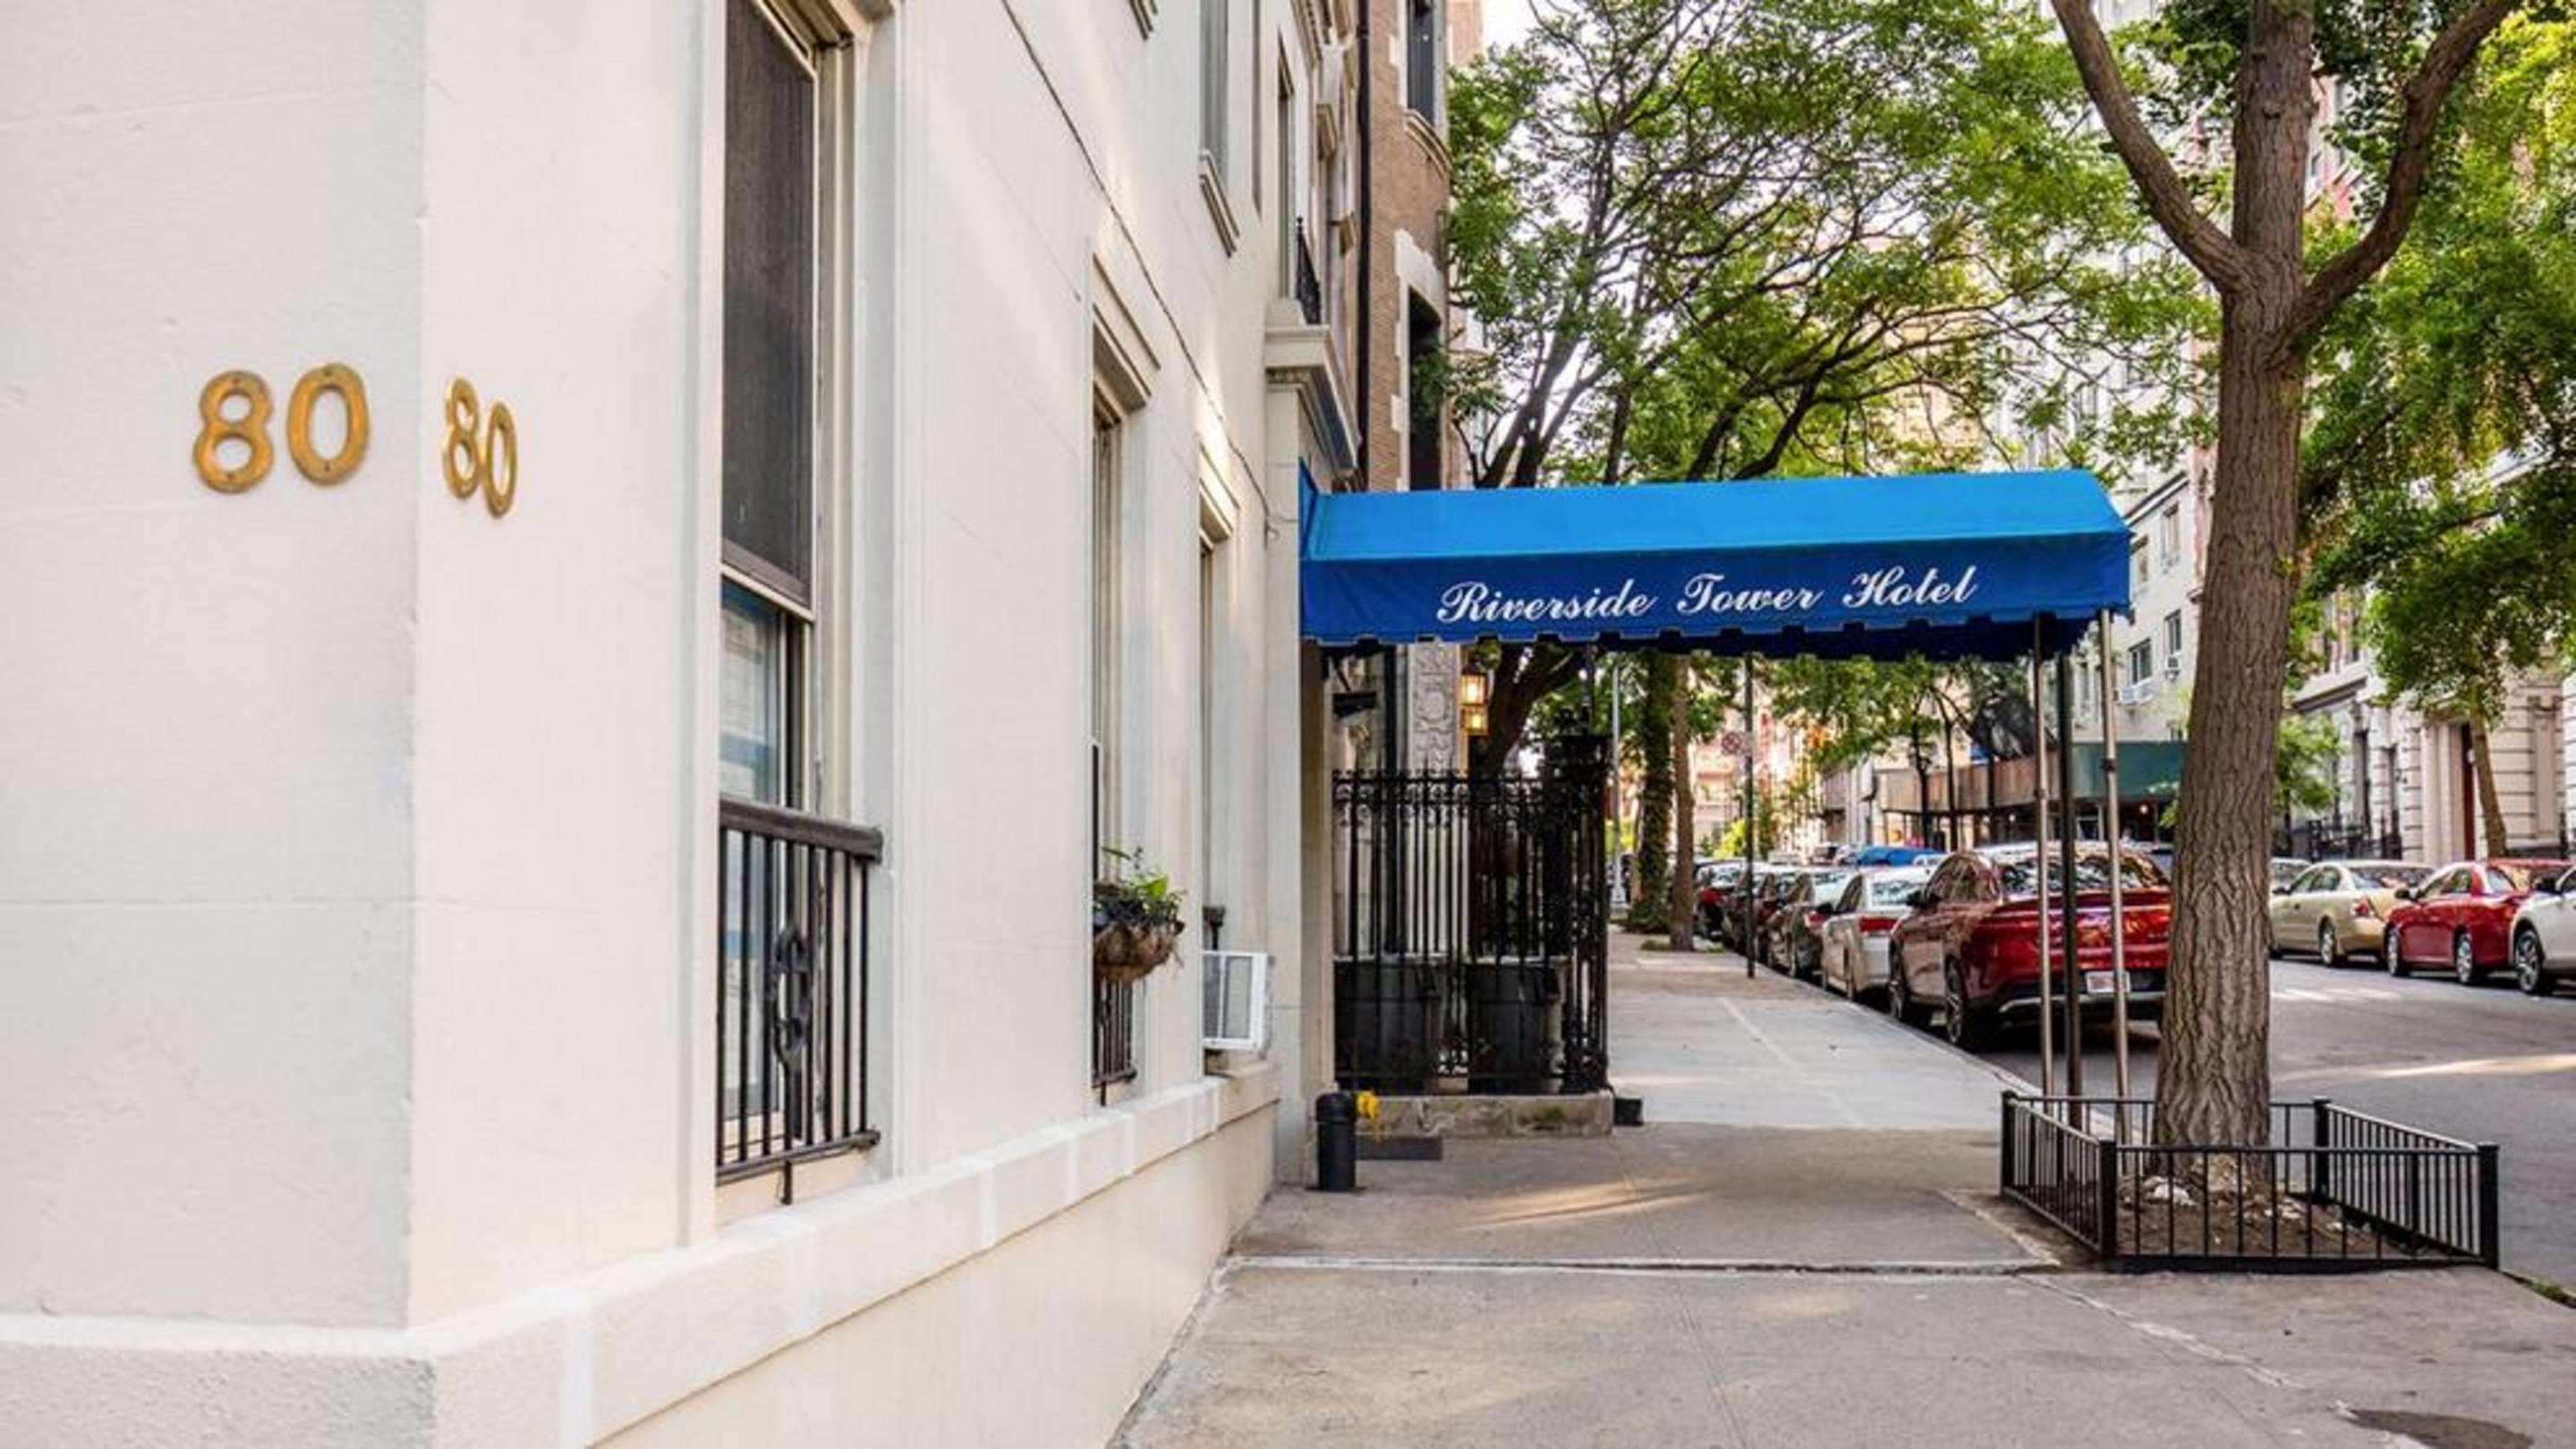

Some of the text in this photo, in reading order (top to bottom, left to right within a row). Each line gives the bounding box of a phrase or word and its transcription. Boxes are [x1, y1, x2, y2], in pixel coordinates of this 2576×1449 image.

[192, 362, 370, 494] 80
[443, 376, 517, 519] 80
[1436, 565, 1977, 623] Riverside Tower Hotel
